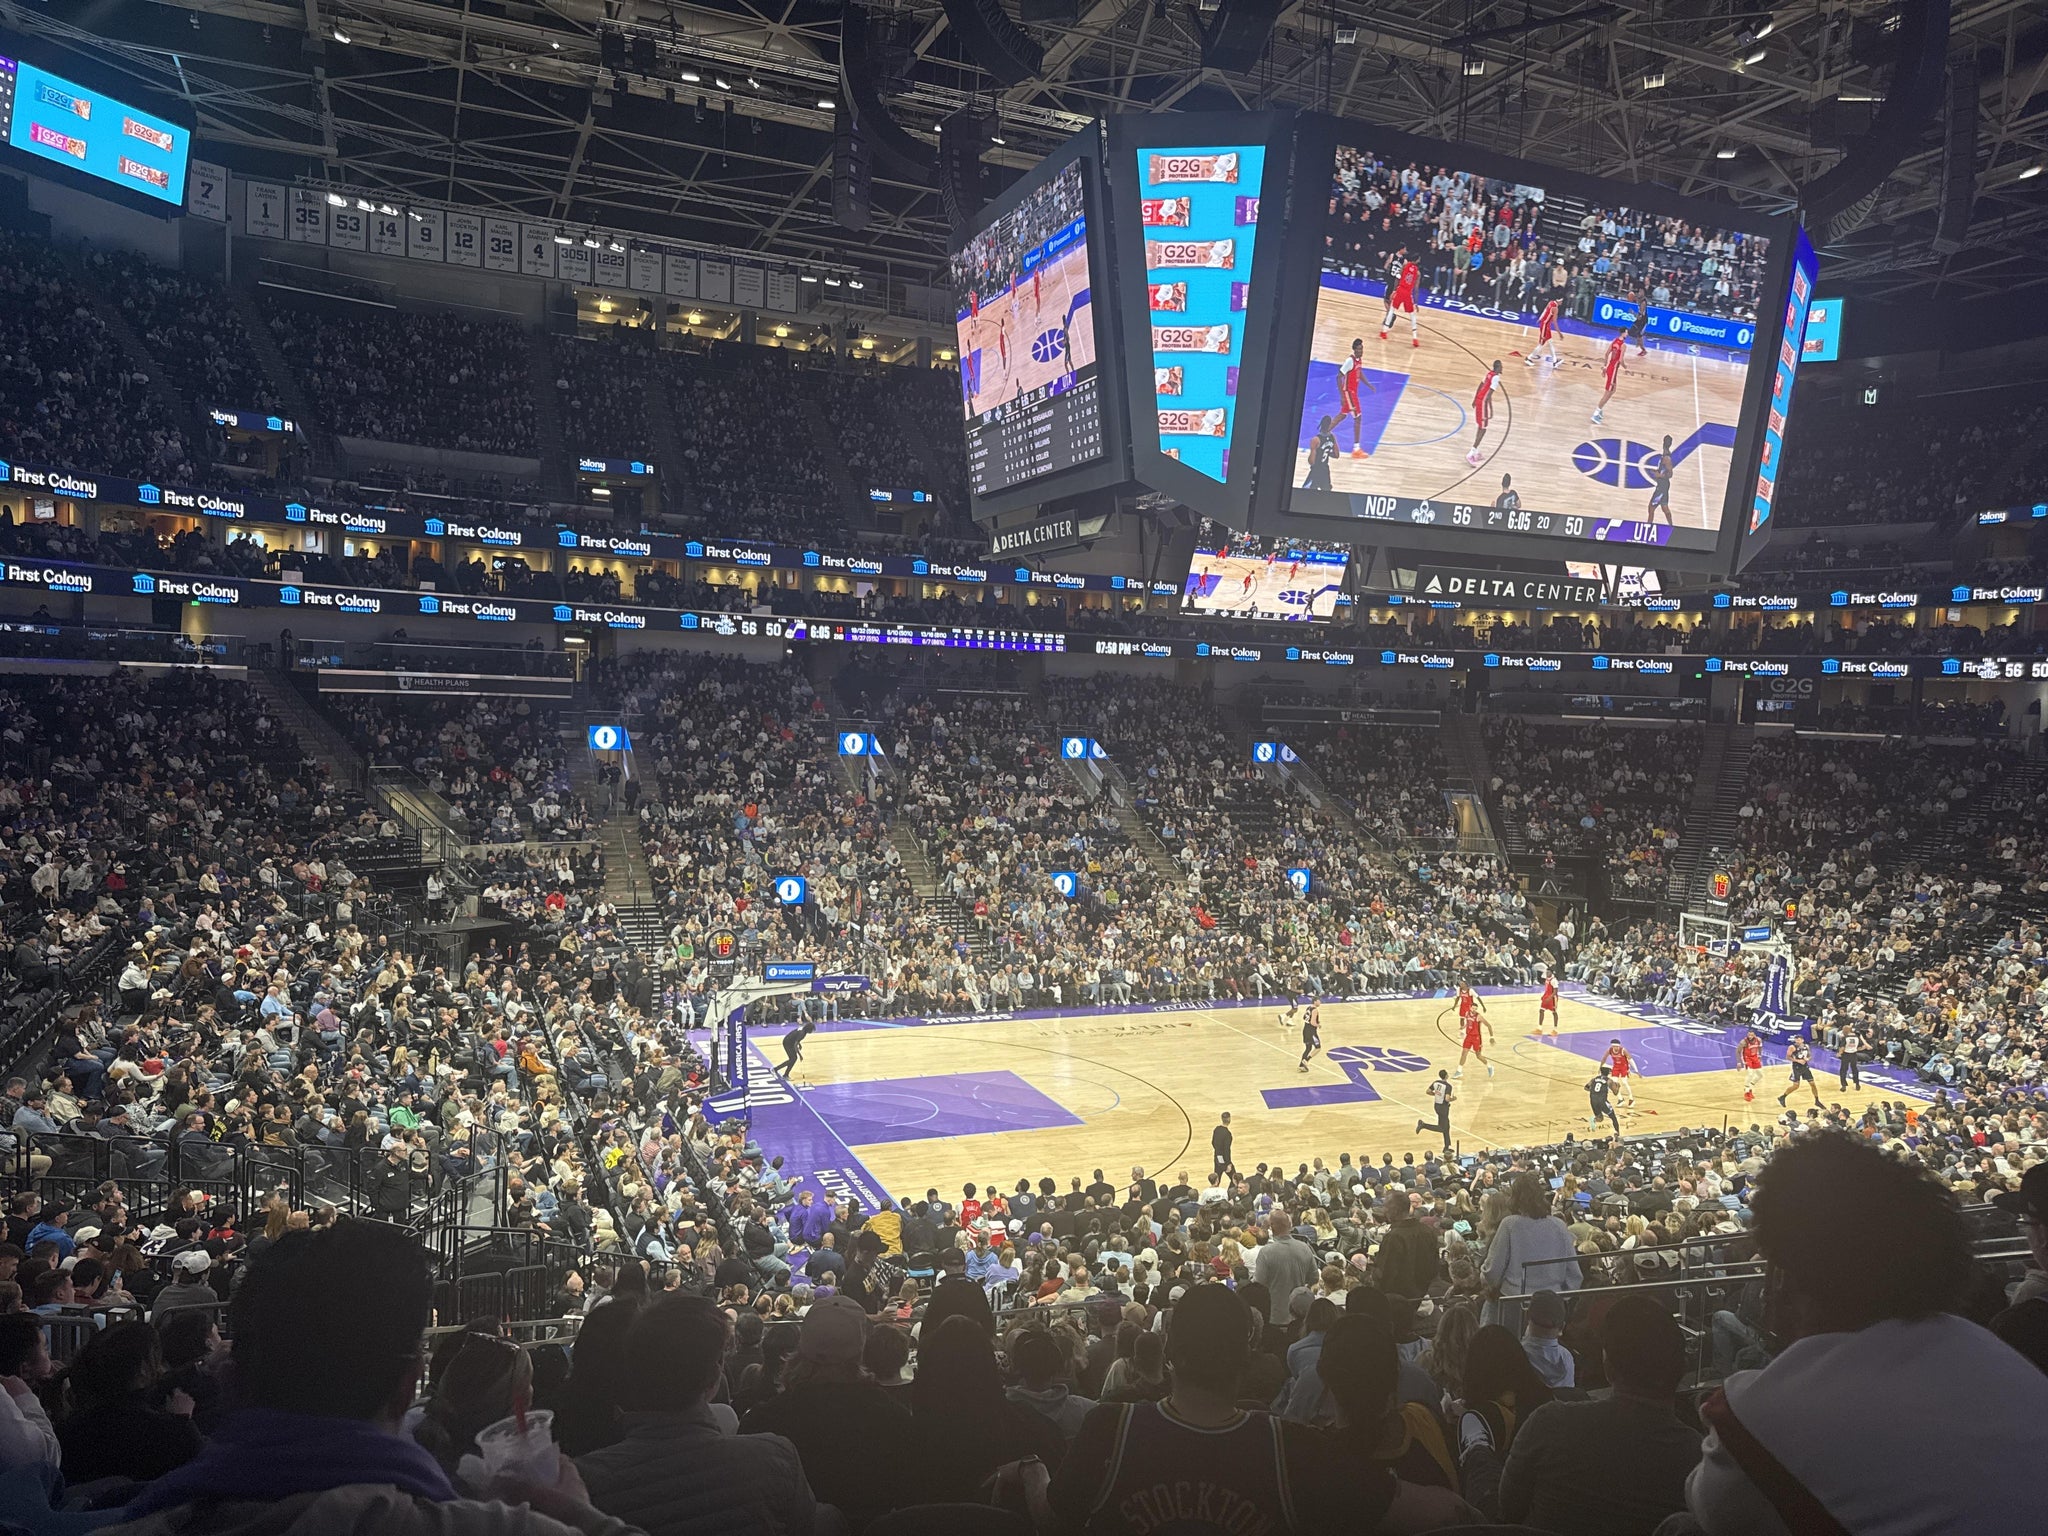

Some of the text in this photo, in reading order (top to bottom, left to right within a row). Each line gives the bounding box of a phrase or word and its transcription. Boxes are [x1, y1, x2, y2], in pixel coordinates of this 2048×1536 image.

[47, 89, 68, 104] G2G
[42, 130, 64, 144] G2G
[134, 124, 152, 137] G2G
[129, 161, 148, 176] G2G
[1168, 159, 1200, 173] G2G
[201, 182, 213, 198] 7
[262, 203, 269, 218] 1
[295, 208, 319, 225] 35
[336, 214, 360, 232] 53
[378, 220, 397, 237] 14
[450, 222, 478, 231] STOCKTON
[420, 227, 431, 242] 9
[455, 232, 473, 248] 12
[490, 237, 513, 254] 32
[533, 244, 544, 259] 4
[1164, 245, 1196, 258] G2G
[561, 248, 588, 262] 3051
[597, 253, 625, 267] 1223
[1444, 300, 1520, 321] PACS
[1161, 329, 1193, 343] G2G
[1682, 322, 1726, 338] 1Password
[1159, 412, 1189, 425] G2G
[14, 467, 96, 498] First Colony
[55, 488, 88, 498] MORTGAGE
[165, 491, 244, 518] First Colony
[203, 509, 236, 517] MORTGAGE
[1365, 496, 1658, 542] NOP 56 2ND 6:05 20 50 UTA
[310, 509, 385, 532] First Colony
[346, 525, 377, 533] MORTGAGE
[448, 524, 521, 545] First Colony
[1001, 520, 1072, 550] DELTA CENTER
[581, 536, 650, 555] First Colony
[707, 546, 770, 565] First Colony
[823, 556, 882, 573] First Colony
[9, 566, 91, 591] First Colony
[931, 564, 986, 581] First Colony
[1032, 572, 1084, 588] First Colony
[49, 584, 83, 592] MORTGAGE
[159, 580, 238, 604] First Colony
[1449, 577, 1596, 603] DELTA CENTER
[1973, 587, 2042, 601] First Colony
[305, 592, 380, 612] First Colony
[1644, 597, 1680, 609] Colony
[1733, 596, 1797, 609] First Colony
[1851, 592, 1917, 606] First Colony
[443, 601, 515, 620] First Colony
[576, 610, 645, 628] First Colony
[742, 621, 830, 639] 56 50 6:05
[1119, 642, 1131, 655] PM
[1142, 643, 1171, 656] Colony
[1212, 646, 1260, 660] First Colony
[1302, 651, 1353, 664] First Colony
[1398, 654, 1454, 667] First Colony
[1502, 657, 1561, 670] First Colony
[1612, 659, 1672, 672] First Colony
[1725, 661, 1788, 675] First Colony
[1842, 662, 1908, 676] First Colony
[2005, 663, 2048, 677] 56 50
[414, 678, 470, 687] HEALTH PLANS
[1770, 678, 1813, 692] G2G
[718, 945, 730, 955] 19
[778, 968, 811, 976] 1Password
[1594, 1082, 1601, 1092] 8
